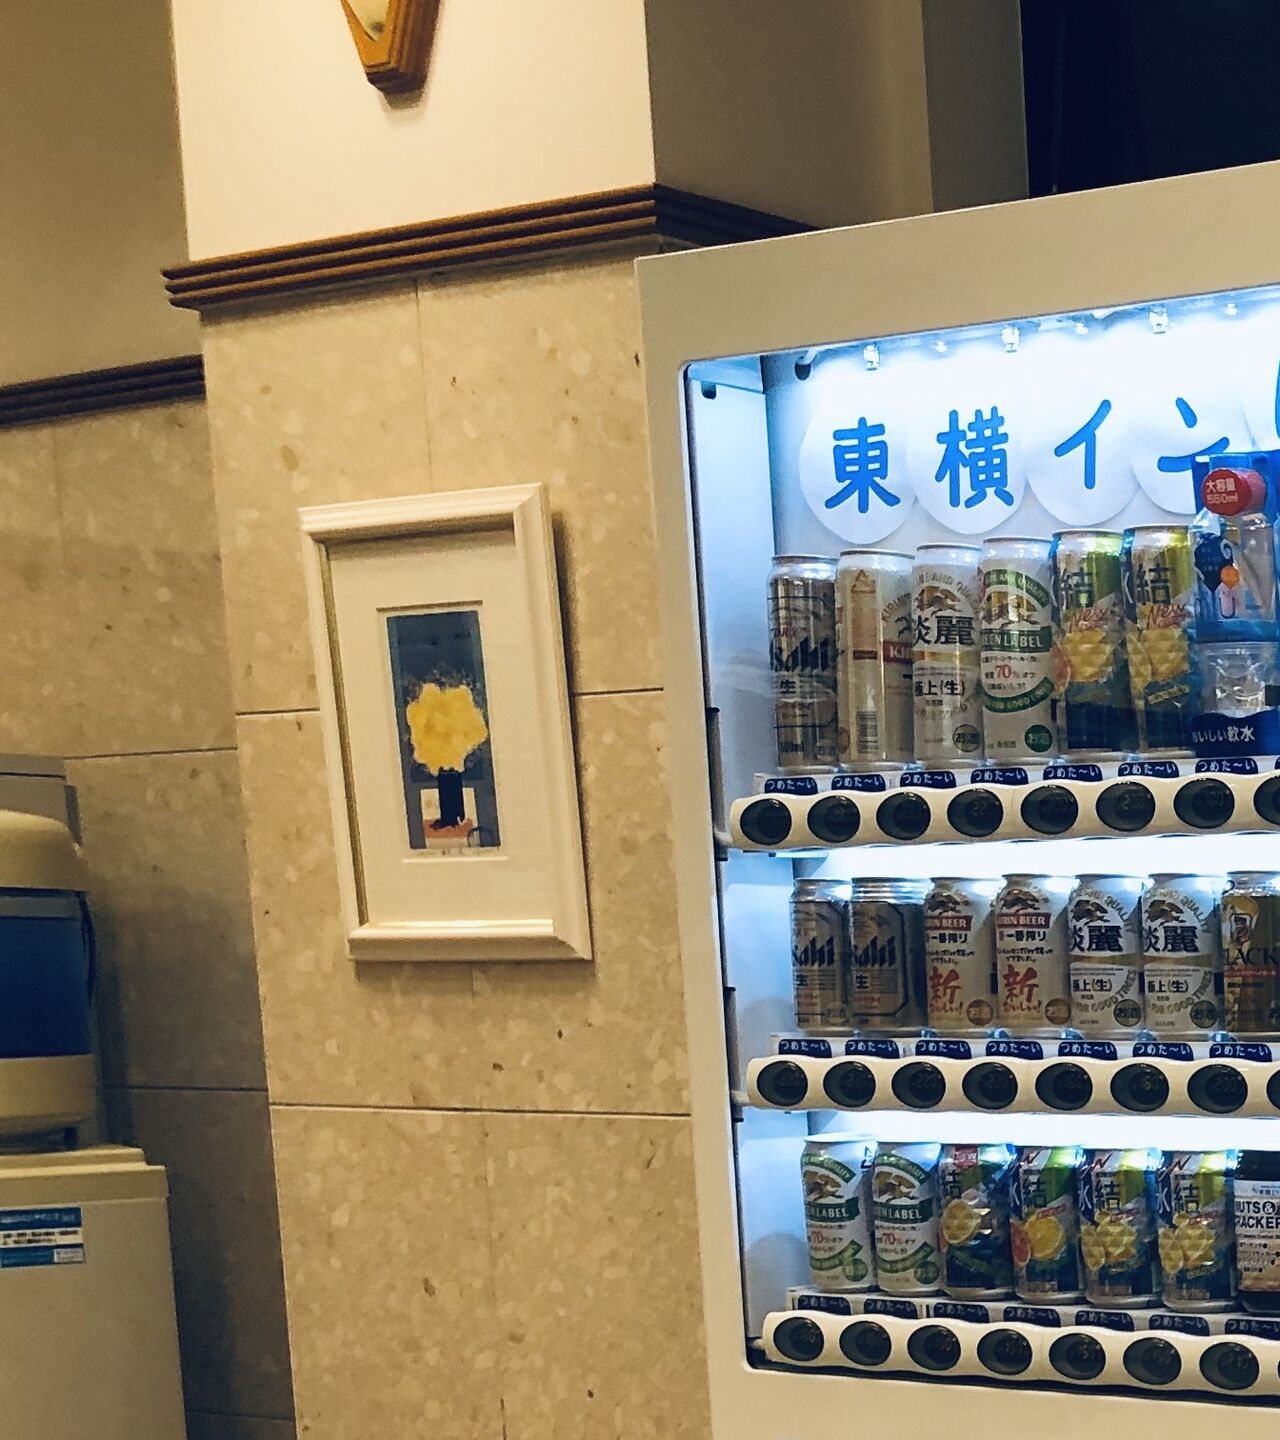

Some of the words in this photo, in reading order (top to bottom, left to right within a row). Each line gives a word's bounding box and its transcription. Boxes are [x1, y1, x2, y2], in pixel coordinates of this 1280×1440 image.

[1206, 478, 1236, 492] 大容量
[1206, 493, 1239, 505] 550ml
[941, 918, 966, 928] BEER
[1020, 916, 1045, 925] BEER
[930, 966, 961, 1003] 新
[1004, 965, 1039, 1003] 新
